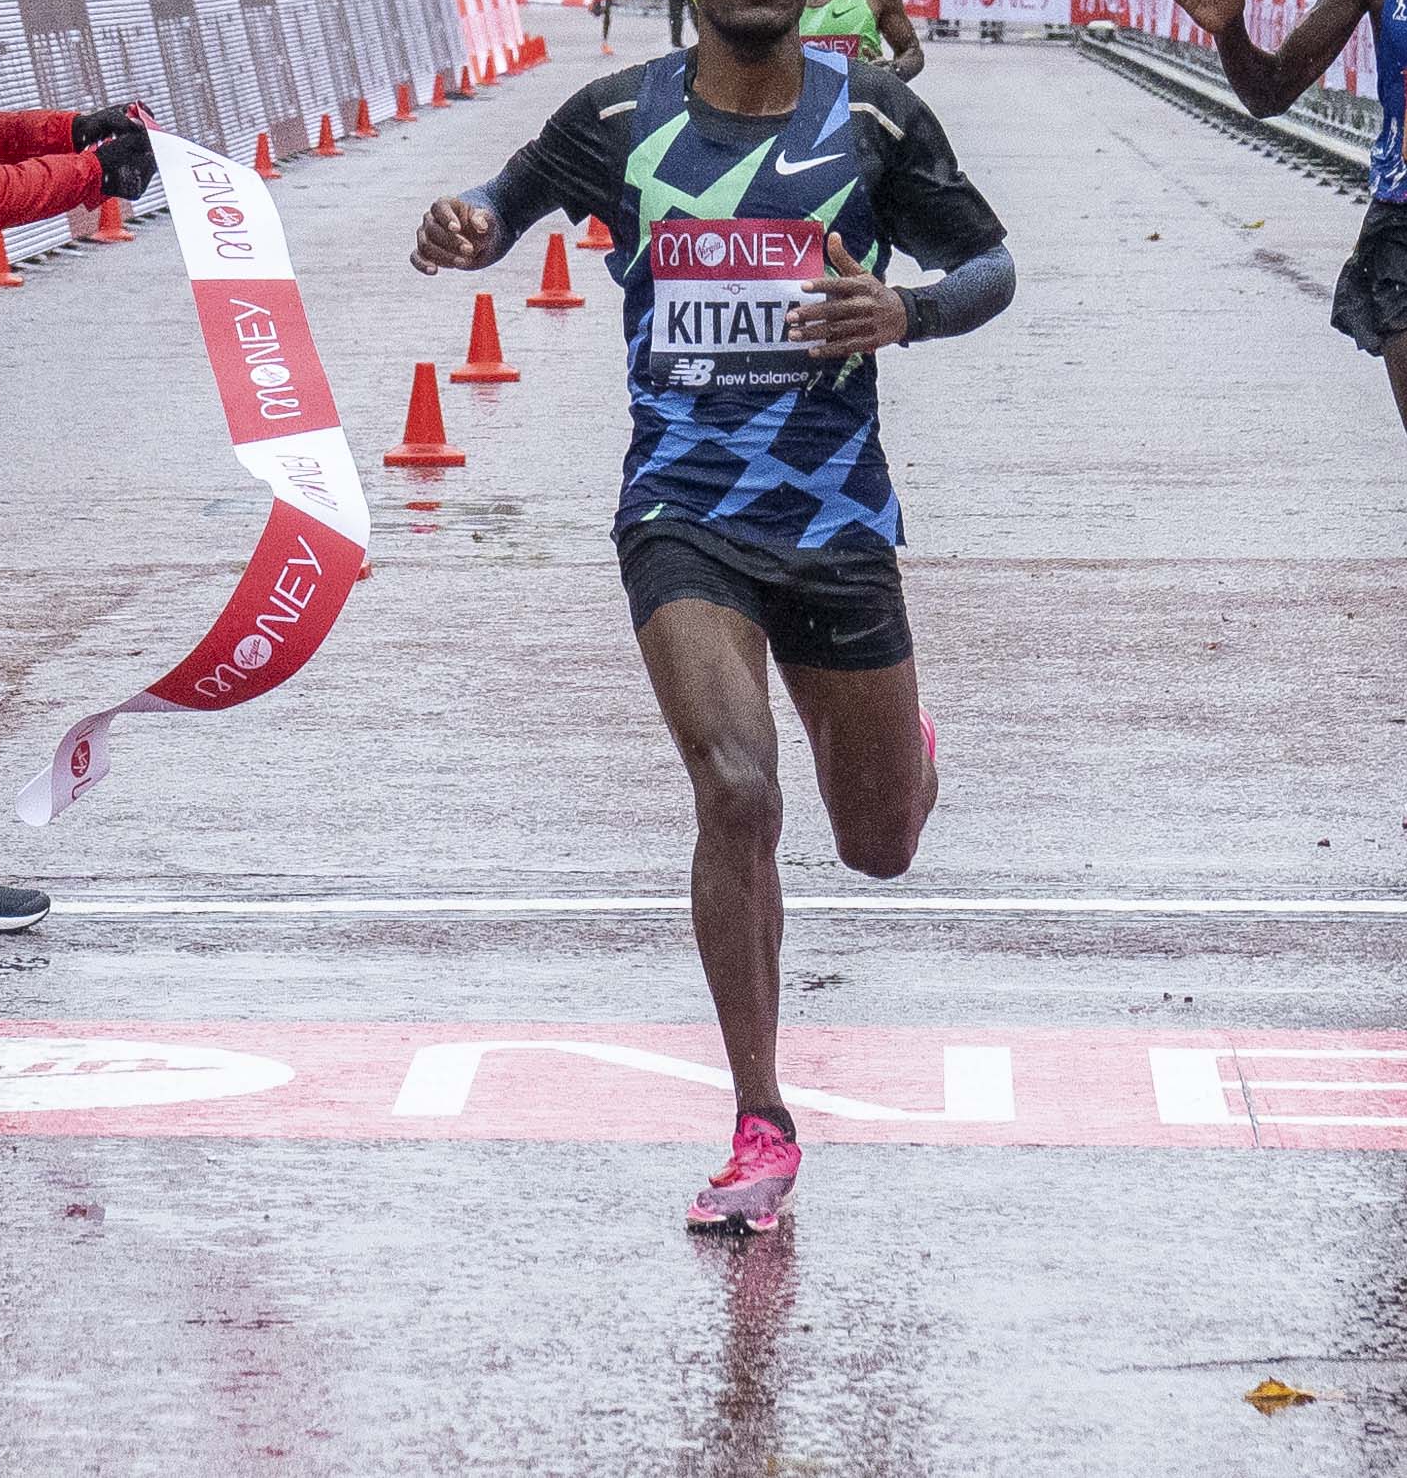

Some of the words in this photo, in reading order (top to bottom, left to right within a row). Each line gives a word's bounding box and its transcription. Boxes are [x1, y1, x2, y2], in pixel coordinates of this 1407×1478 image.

[187, 151, 255, 260] MONEY
[658, 232, 814, 267] MONEY
[697, 237, 724, 262] Virgin
[230, 298, 302, 419] MONEY
[716, 373, 746, 386] new
[749, 369, 810, 385] balance
[194, 535, 323, 698] MONEY
